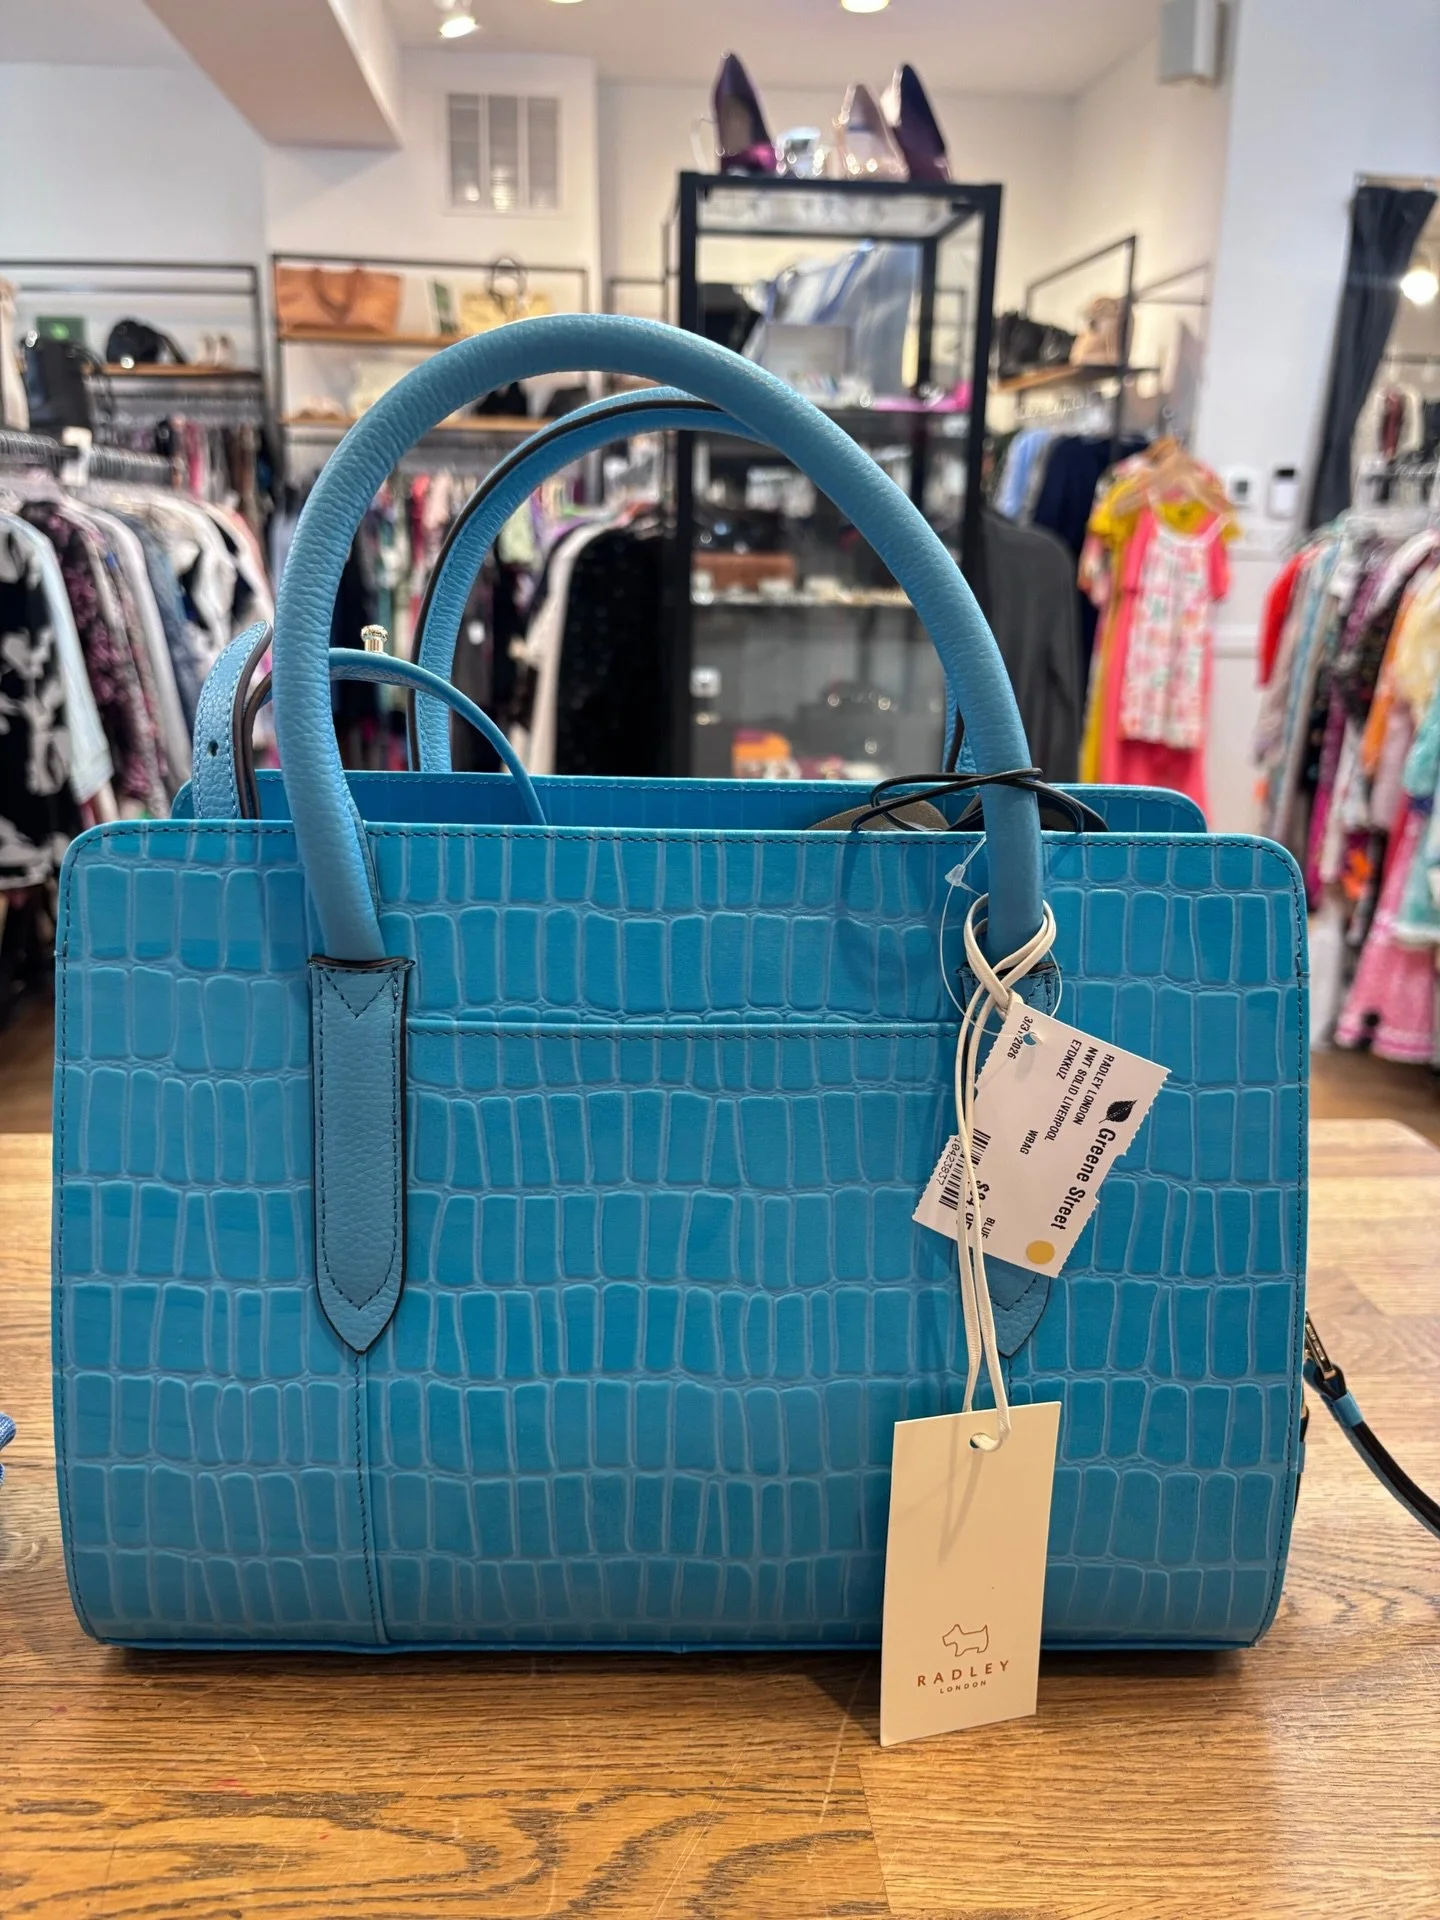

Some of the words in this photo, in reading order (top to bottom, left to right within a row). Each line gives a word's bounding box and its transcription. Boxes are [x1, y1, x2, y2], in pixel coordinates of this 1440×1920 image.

[1056, 1039, 1082, 1080] E7DKKUZ
[1081, 1046, 1099, 1069] NWT
[1091, 1053, 1115, 1090] RADLEY
[1067, 1068, 1087, 1095] SOLID
[1044, 1095, 1074, 1141] LIVERPOOL
[1072, 1089, 1097, 1126] LONDON
[1019, 1129, 1039, 1155] WBAG
[1076, 1127, 1116, 1183] Greene
[1050, 1186, 1086, 1231] Street
[917, 1660, 1009, 1687] RADLEY
[939, 1680, 987, 1694] LONDON
